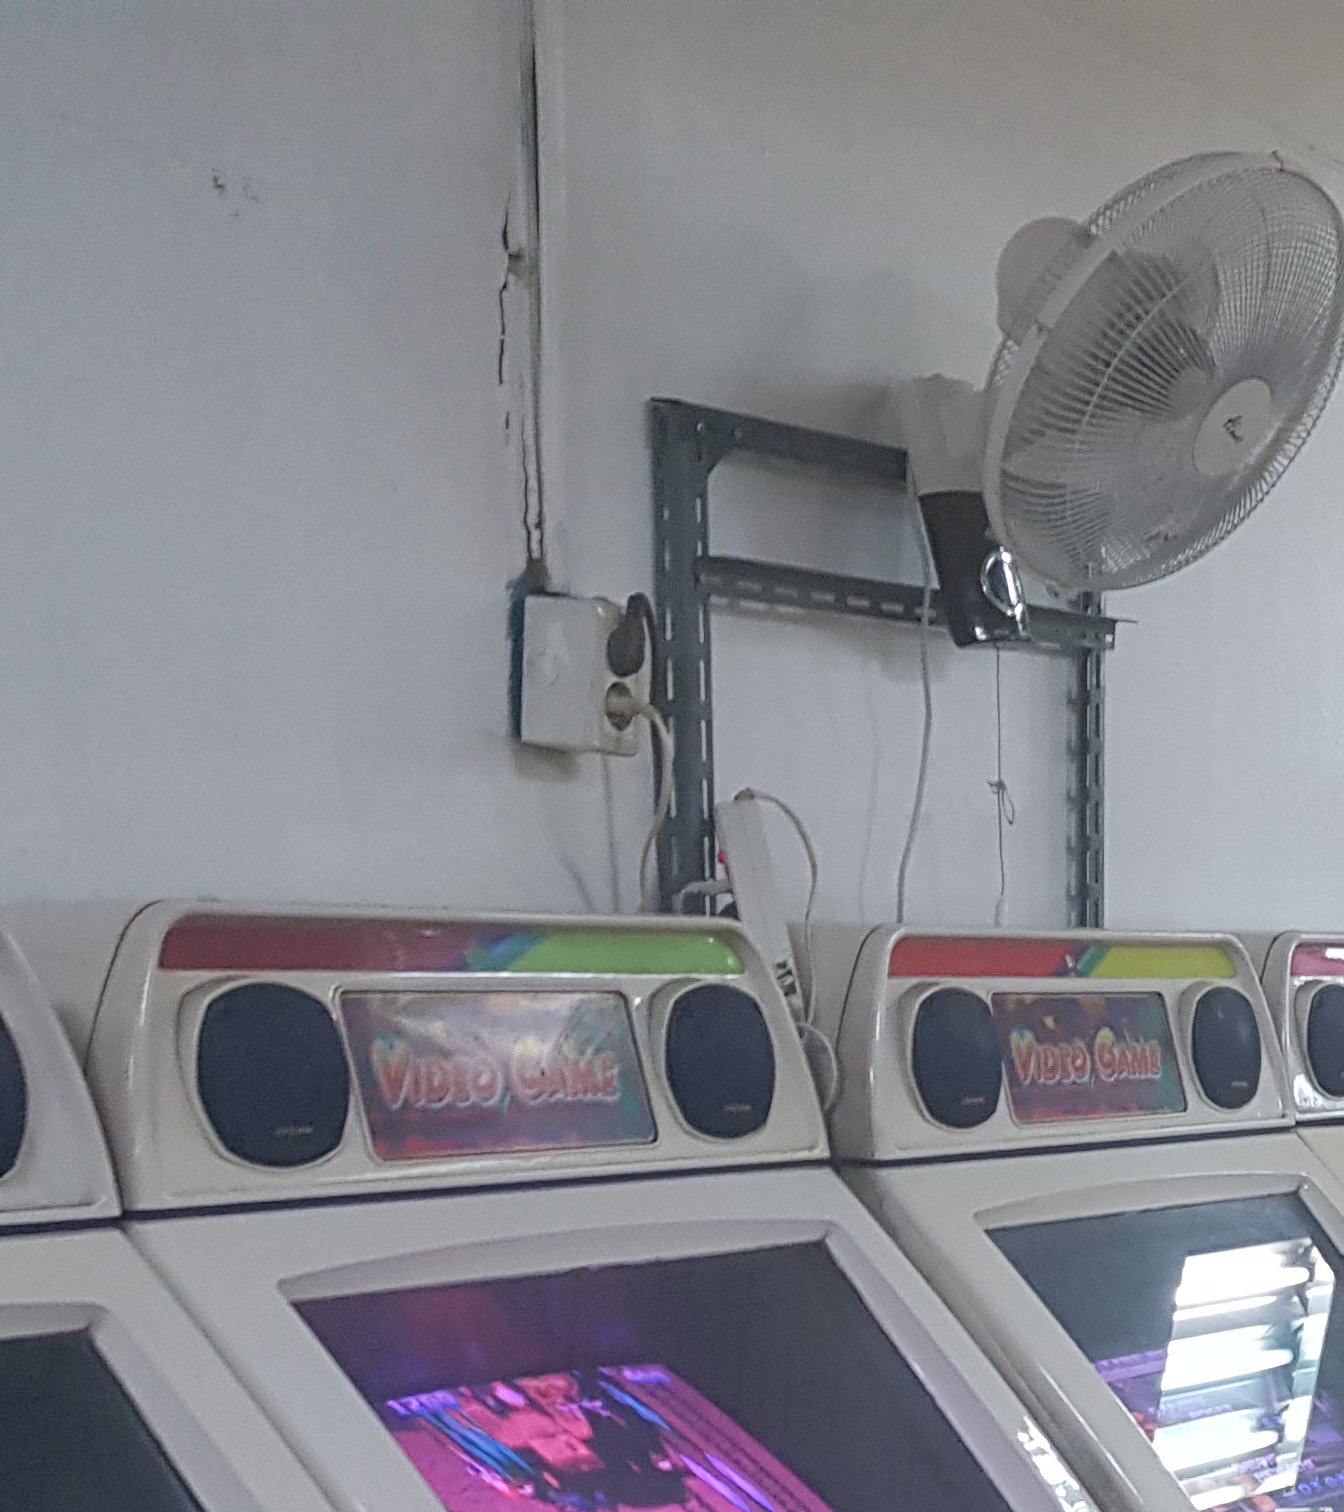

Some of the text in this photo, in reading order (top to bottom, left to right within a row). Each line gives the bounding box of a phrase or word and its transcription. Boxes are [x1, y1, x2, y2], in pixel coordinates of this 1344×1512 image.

[372, 1030, 619, 1110] VIDEO GAME
[1009, 1023, 1162, 1085] VIDEO GAME
